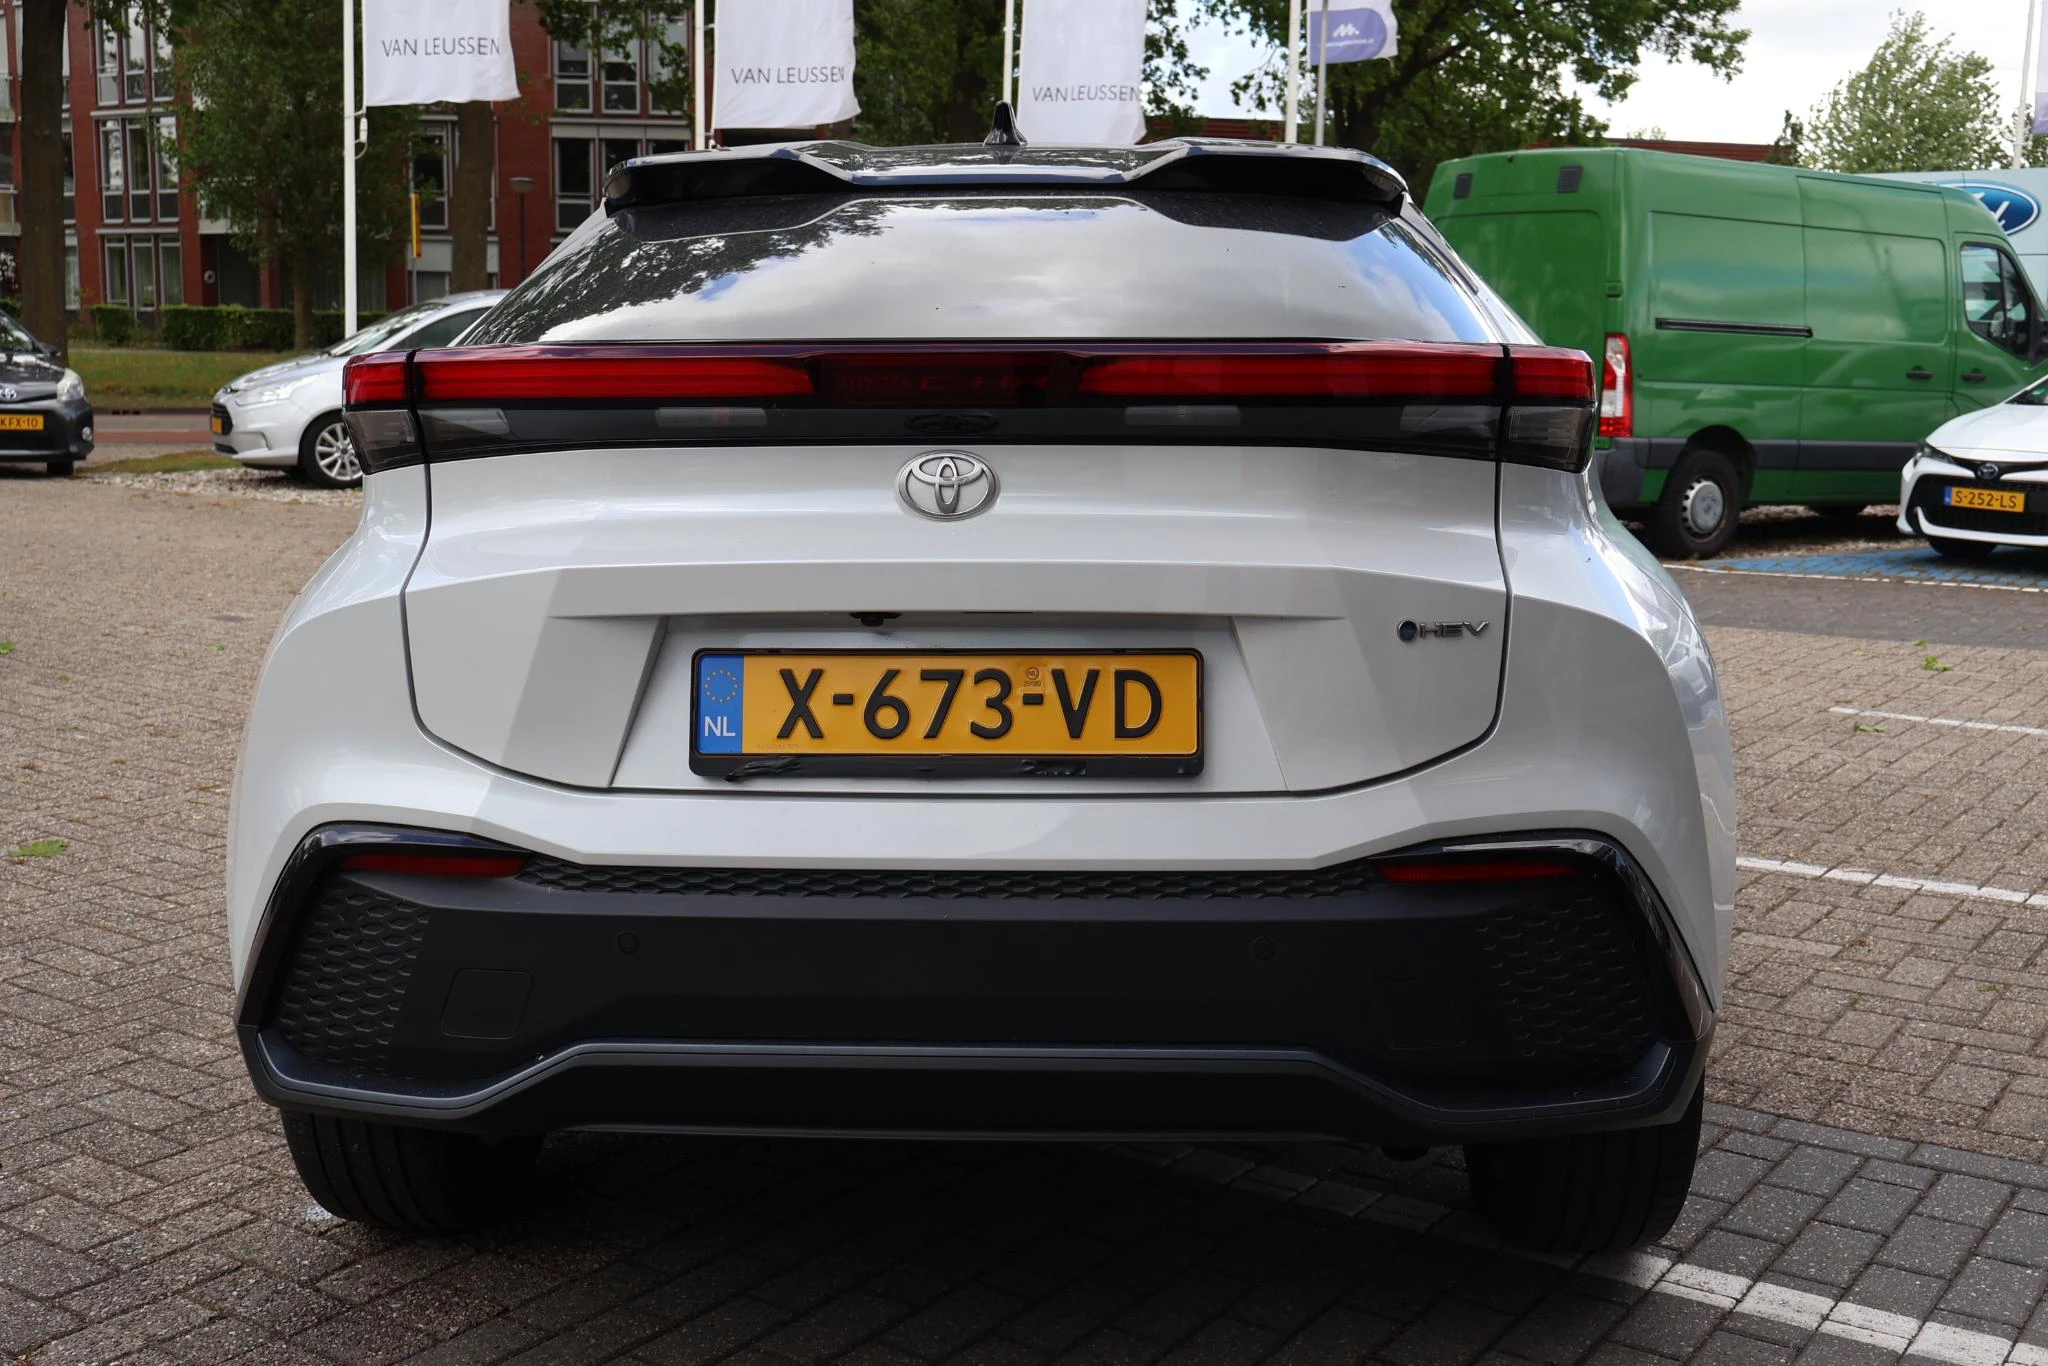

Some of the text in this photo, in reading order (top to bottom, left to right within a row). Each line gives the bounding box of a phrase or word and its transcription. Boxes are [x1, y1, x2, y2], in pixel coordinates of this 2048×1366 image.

[381, 37, 500, 57] VAN LEUSSEN
[731, 67, 771, 84] VAN
[1032, 84, 1140, 102] VAN LEUSSEN
[1954, 490, 2017, 509] S-252-LS
[1419, 621, 1489, 639] HEV
[776, 668, 1162, 740] X-673-VD
[704, 716, 736, 737] NL
